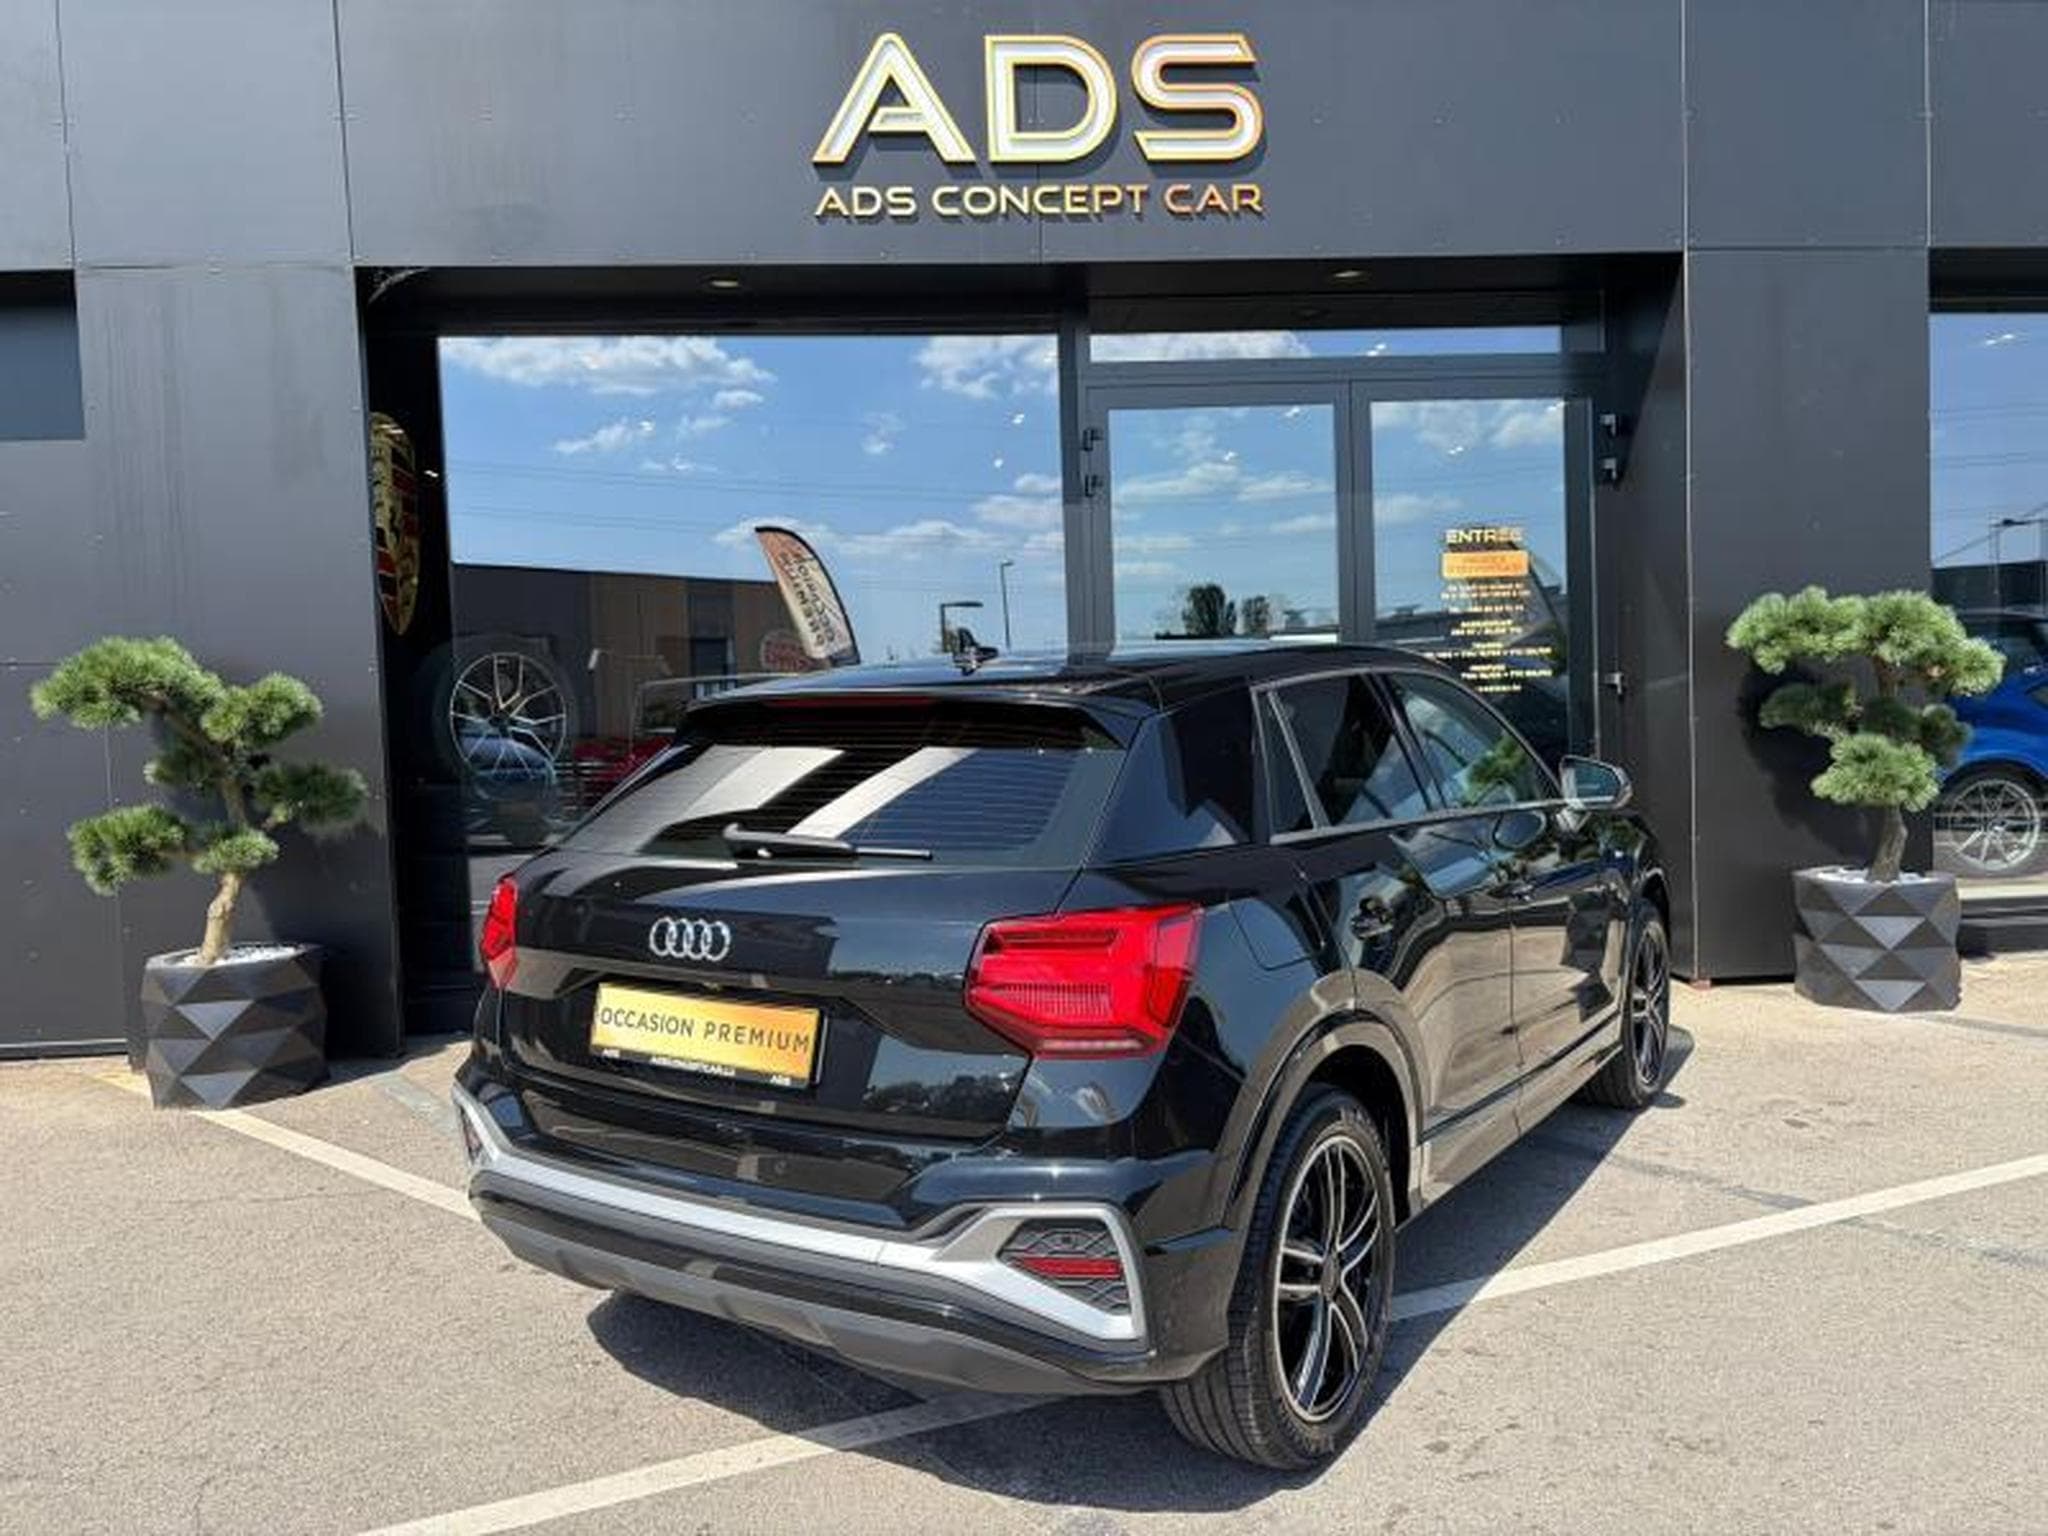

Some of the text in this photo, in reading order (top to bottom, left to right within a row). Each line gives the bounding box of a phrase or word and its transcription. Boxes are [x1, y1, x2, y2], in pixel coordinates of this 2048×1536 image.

[812, 33, 1264, 164] ADS
[815, 183, 1264, 217] ADS CONCEPT CAR
[600, 1006, 810, 1054] OCCASION PREMIUM
